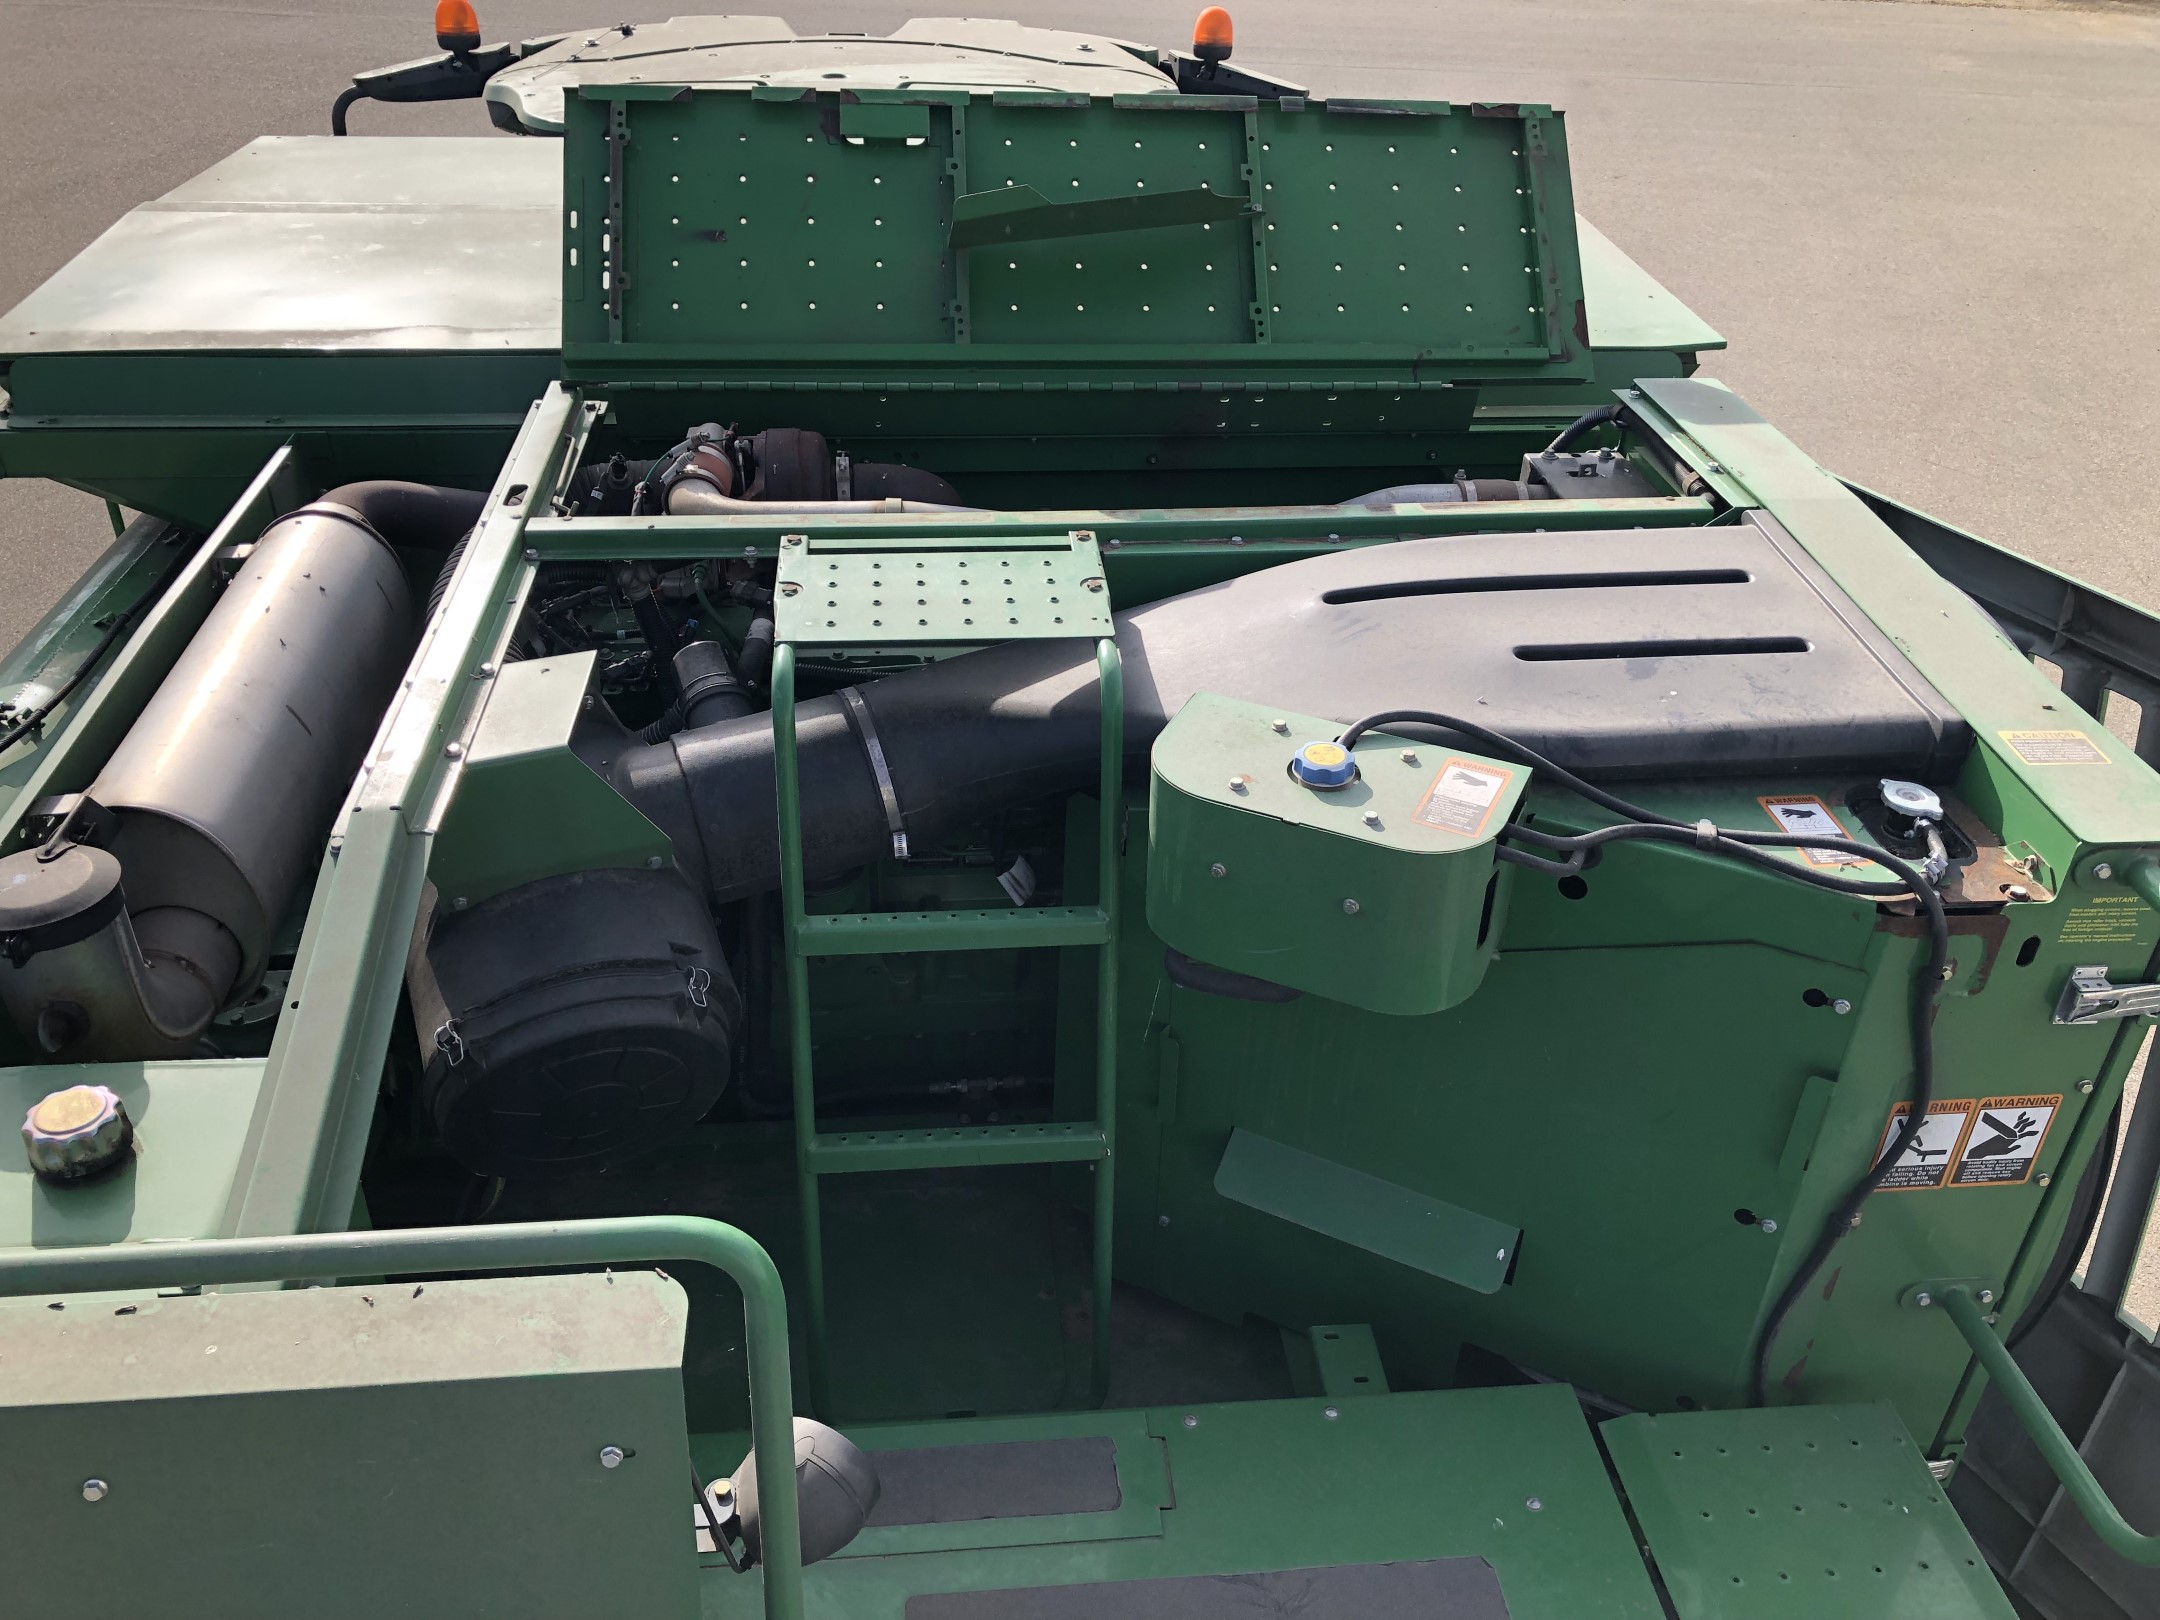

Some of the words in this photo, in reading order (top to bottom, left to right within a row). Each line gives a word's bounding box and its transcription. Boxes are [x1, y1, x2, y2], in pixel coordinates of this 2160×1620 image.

[1464, 762, 1506, 777] WARNING
[1775, 796, 1815, 804] WARNING
[2092, 896, 2140, 904] IMPORTANT
[1994, 1096, 2059, 1108] WARNING
